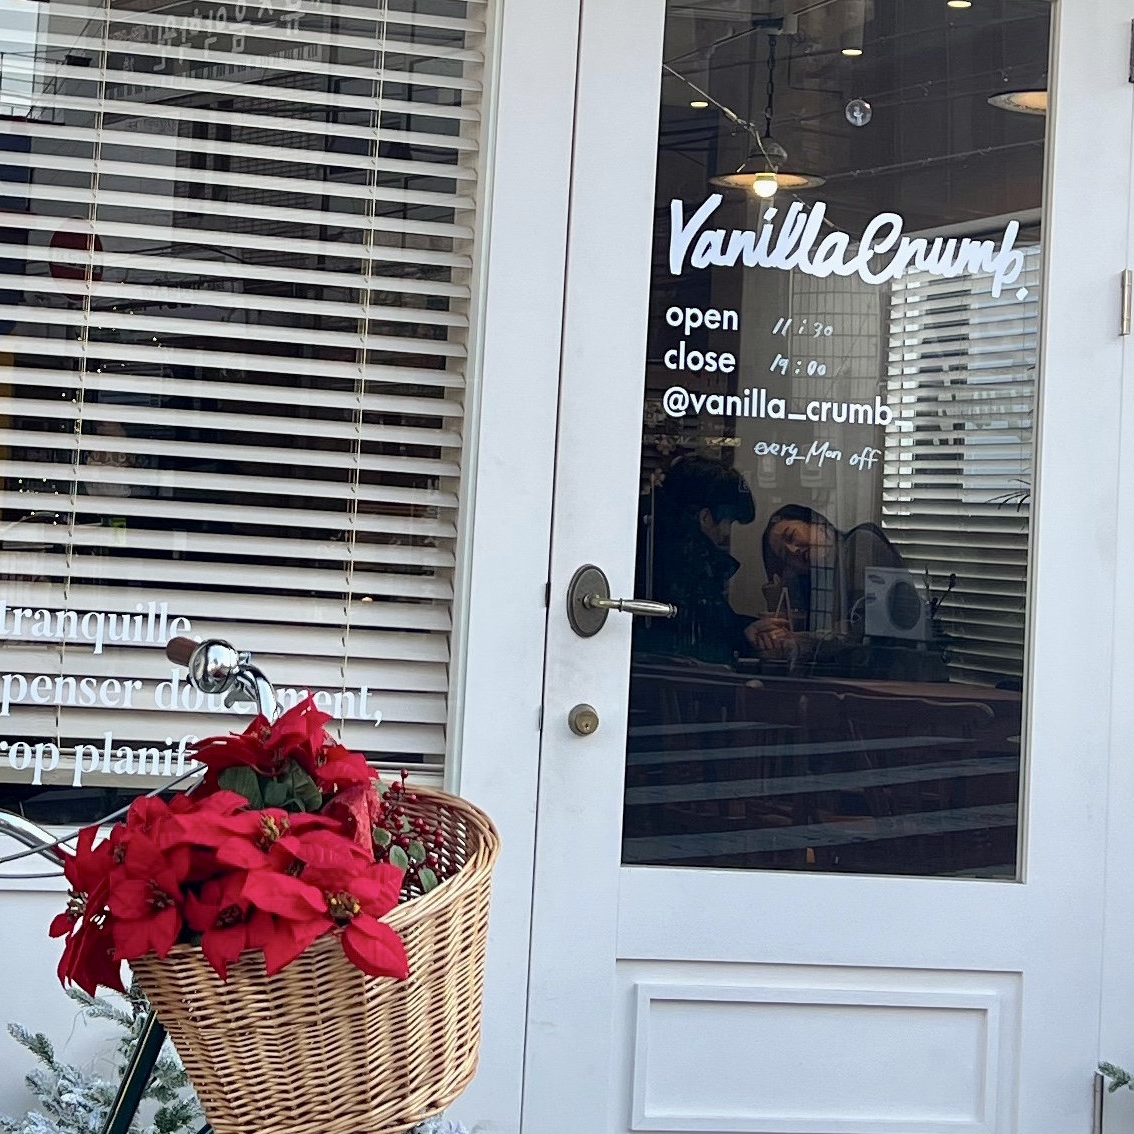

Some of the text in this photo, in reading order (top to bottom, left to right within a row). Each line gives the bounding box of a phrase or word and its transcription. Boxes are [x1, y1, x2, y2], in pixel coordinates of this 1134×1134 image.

[666, 305, 739, 337] open
[663, 341, 737, 374] close
[805, 440, 842, 468] Mon
[849, 446, 882, 471] off
[0, 672, 143, 717] penser
